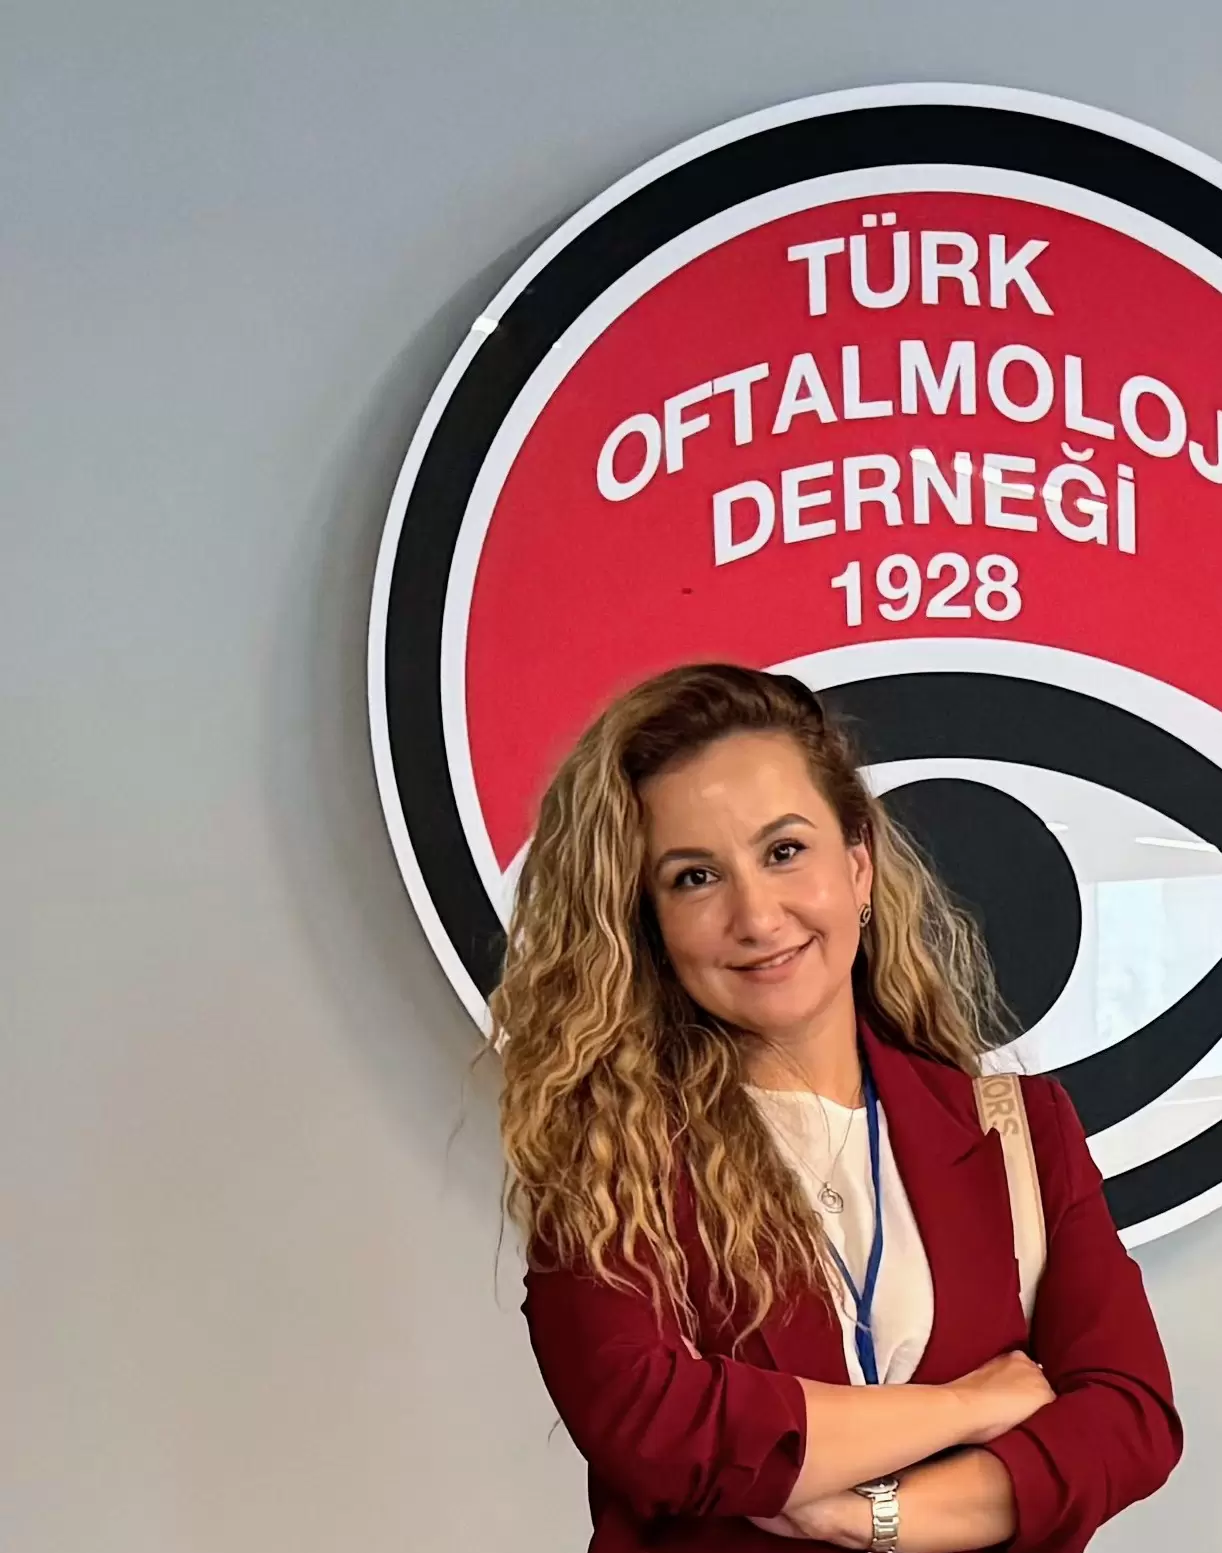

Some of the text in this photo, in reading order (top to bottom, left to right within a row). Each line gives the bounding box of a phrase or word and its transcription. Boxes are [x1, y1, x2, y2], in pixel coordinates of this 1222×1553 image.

[787, 213, 1054, 317] TÜRK
[712, 442, 1136, 566] DERNEĞİ
[831, 552, 1023, 627] 1928
[982, 1075, 1019, 1136] ORS
